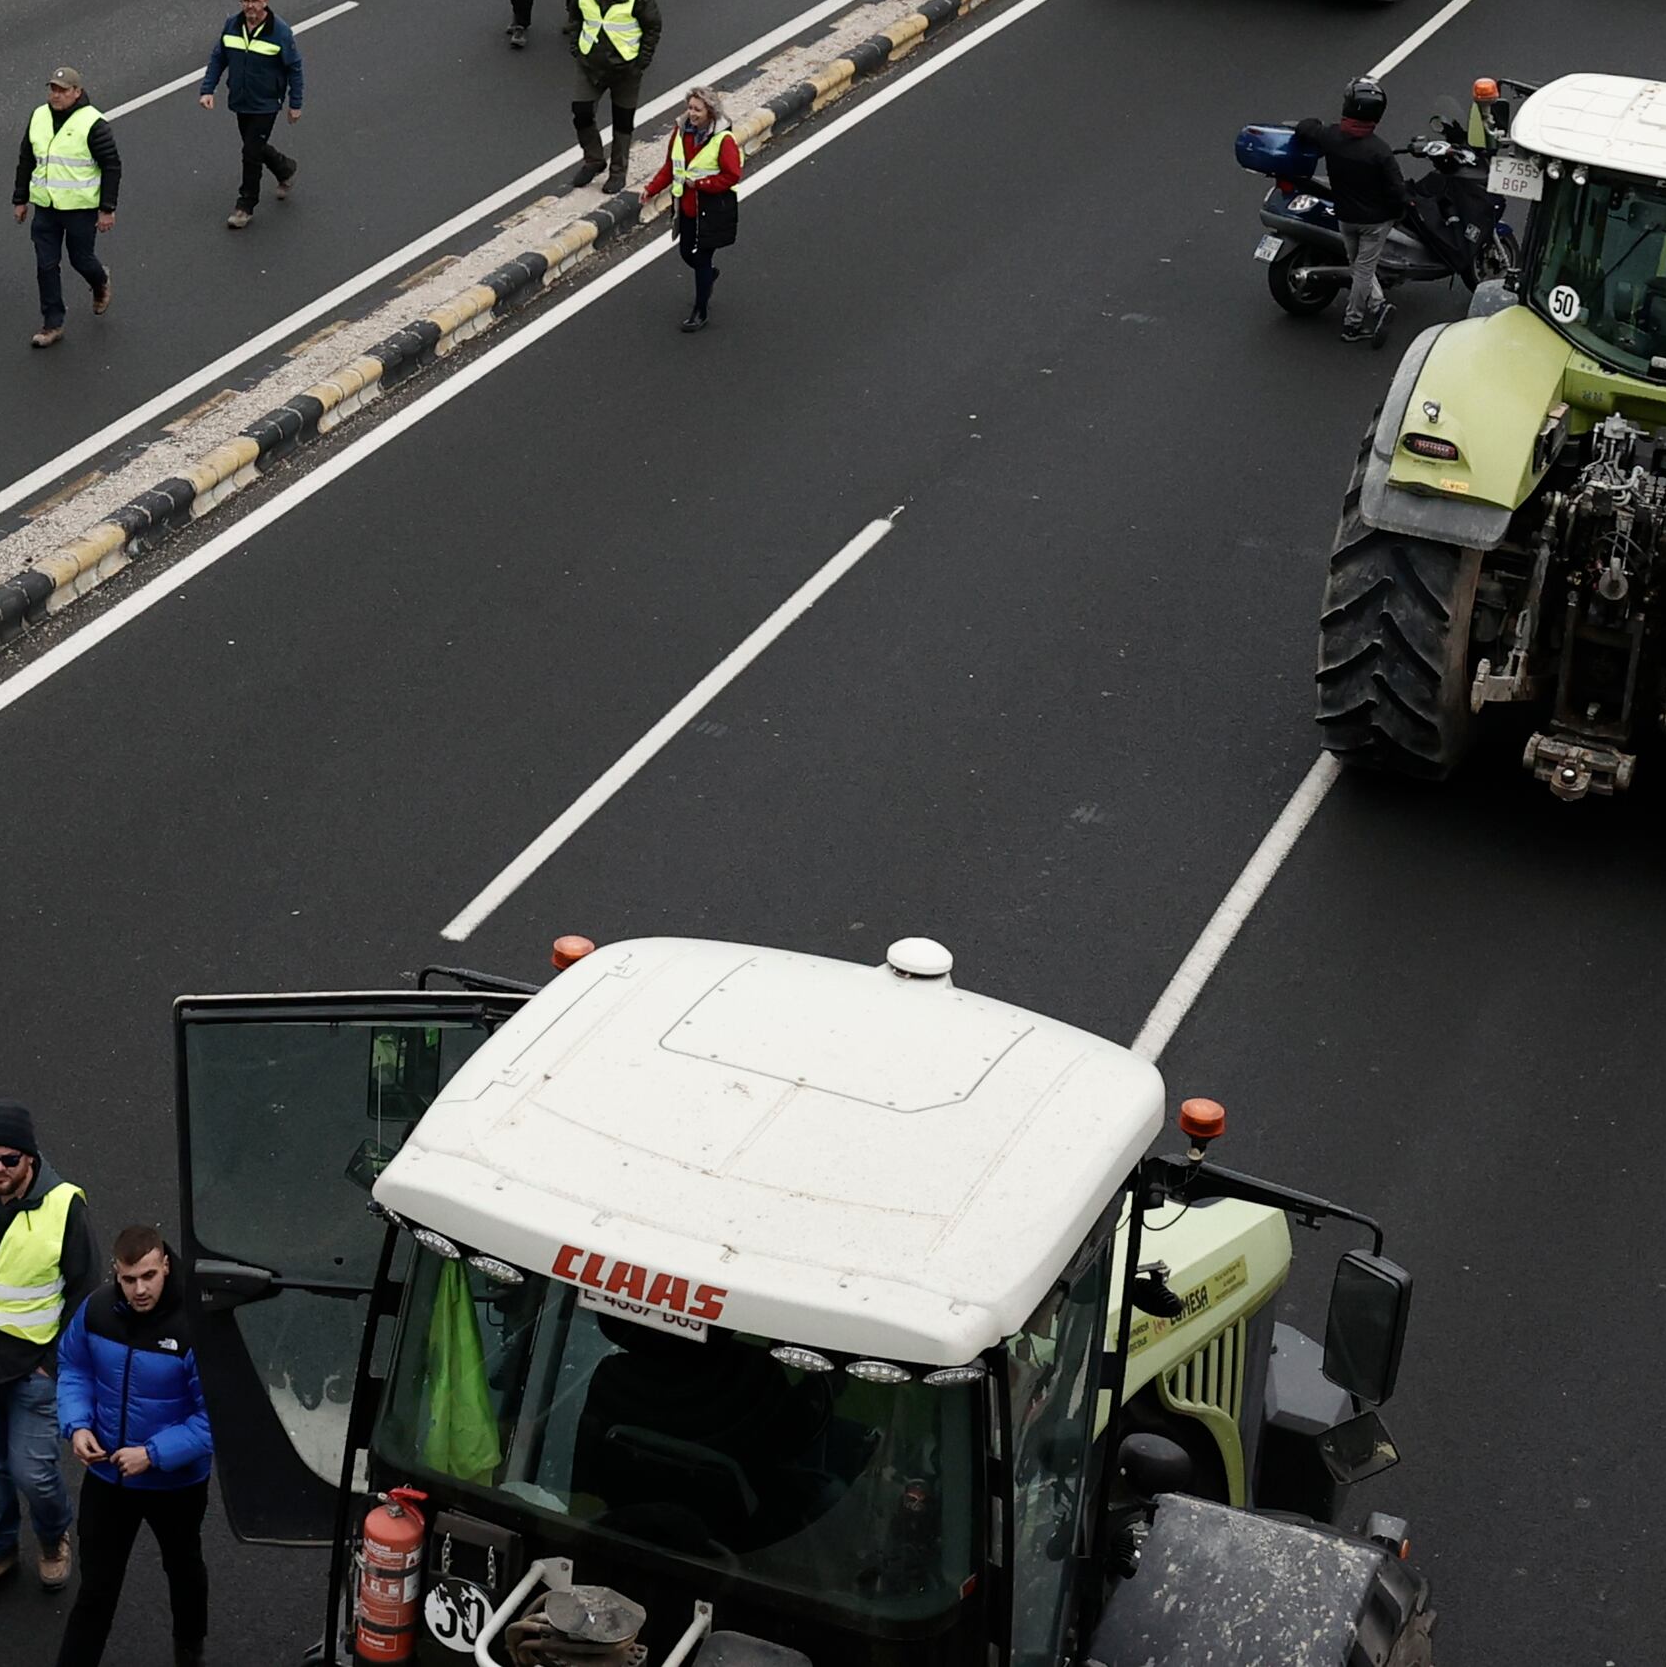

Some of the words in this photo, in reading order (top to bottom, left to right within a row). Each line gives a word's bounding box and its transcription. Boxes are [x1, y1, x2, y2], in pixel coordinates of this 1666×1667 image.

[1495, 159, 1503, 173] E
[1502, 178, 1528, 193] BGP
[1553, 290, 1574, 318] 50
[551, 1244, 728, 1321] CLAAS
